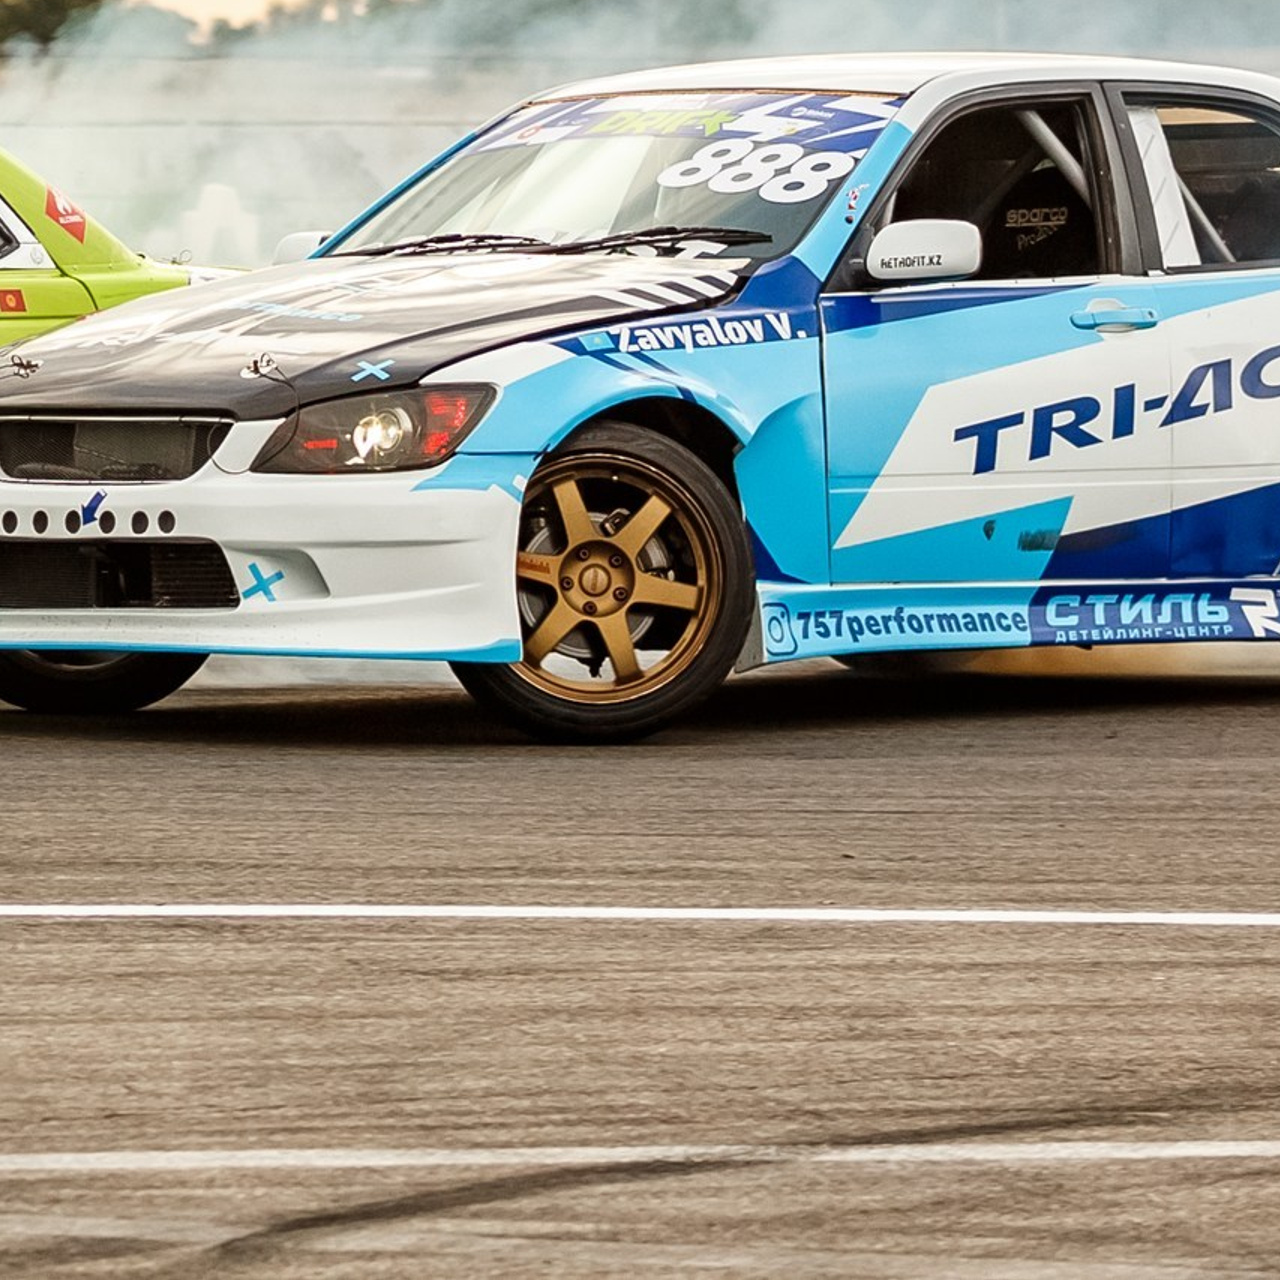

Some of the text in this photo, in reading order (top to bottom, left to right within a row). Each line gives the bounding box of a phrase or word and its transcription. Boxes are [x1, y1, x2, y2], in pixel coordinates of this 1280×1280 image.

[657, 138, 855, 203] 888
[1006, 207, 1068, 223] sparco
[880, 255, 942, 269] RETROFIT.KZ
[609, 313, 807, 353] Zavyalov V.
[797, 607, 1029, 642] 757performance
[1046, 593, 1229, 626] СТИЛЬ
[1055, 625, 1233, 643] ДЕТЕЙЛИНГ-ЦЕНТР
